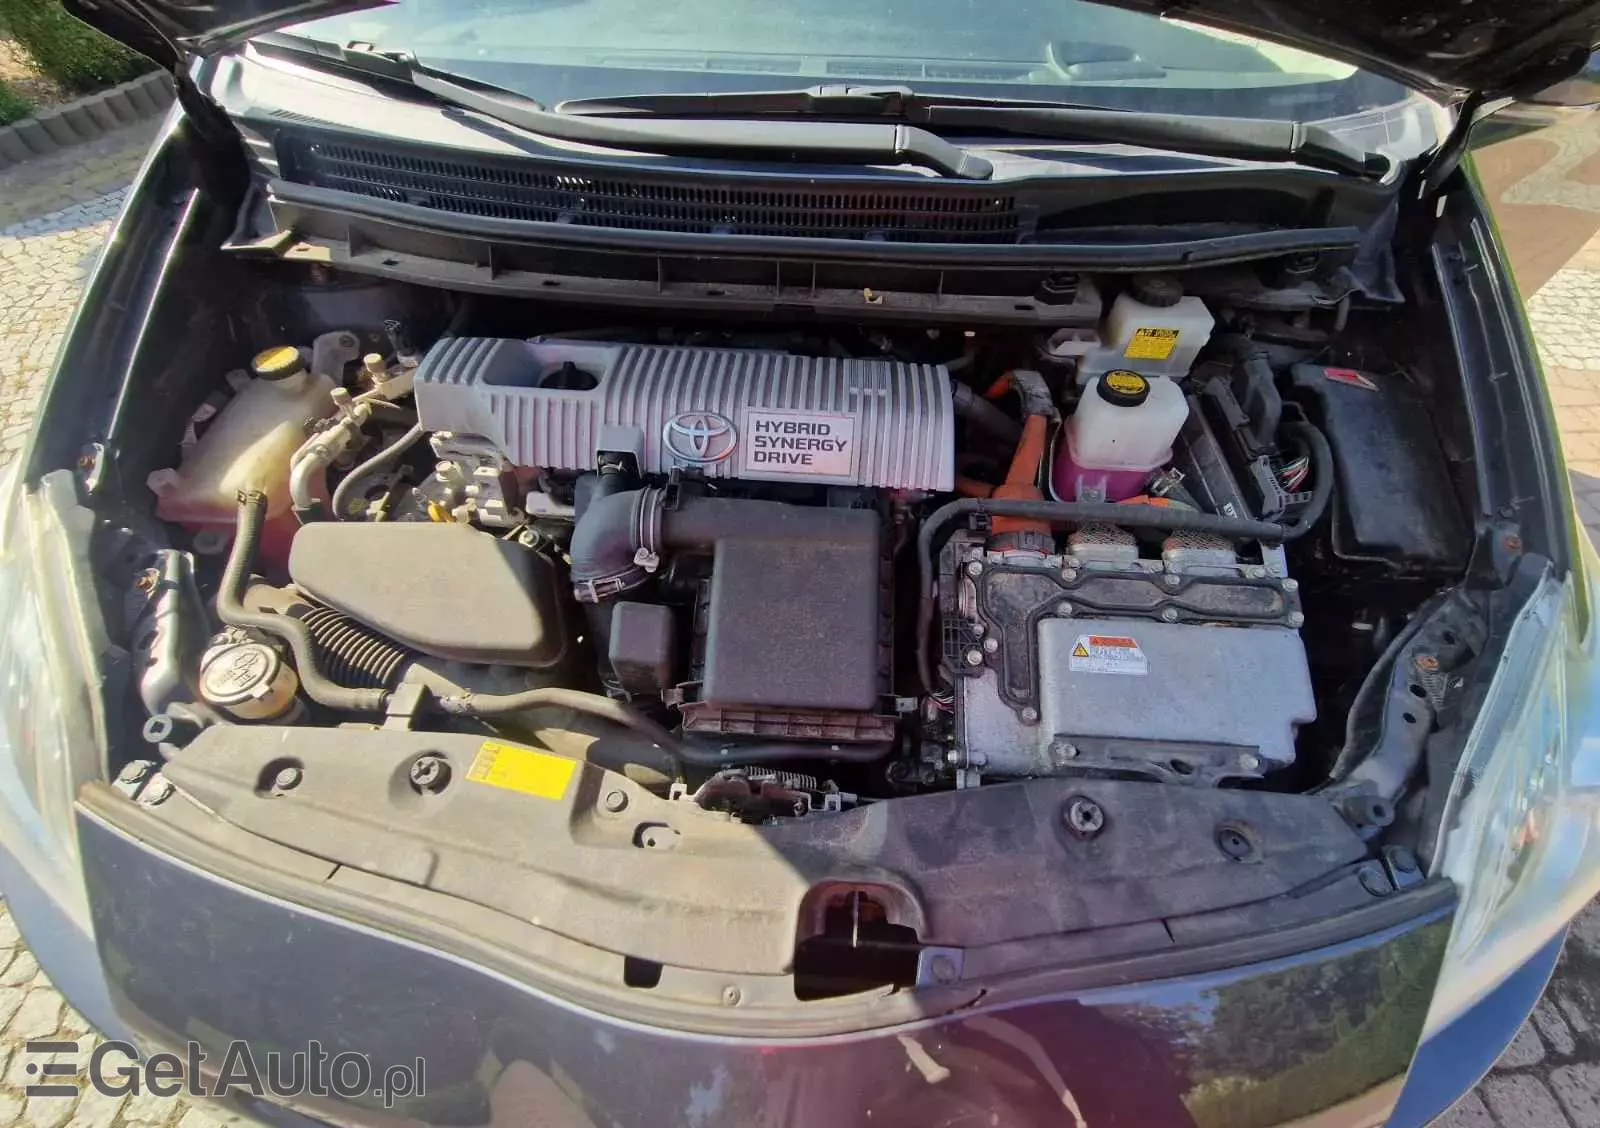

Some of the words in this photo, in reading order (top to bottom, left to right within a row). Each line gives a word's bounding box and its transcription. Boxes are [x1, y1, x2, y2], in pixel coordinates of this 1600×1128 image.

[755, 420, 831, 436] HYBRID
[754, 435, 847, 452] SYNERGY
[753, 451, 813, 465] DRIVE
